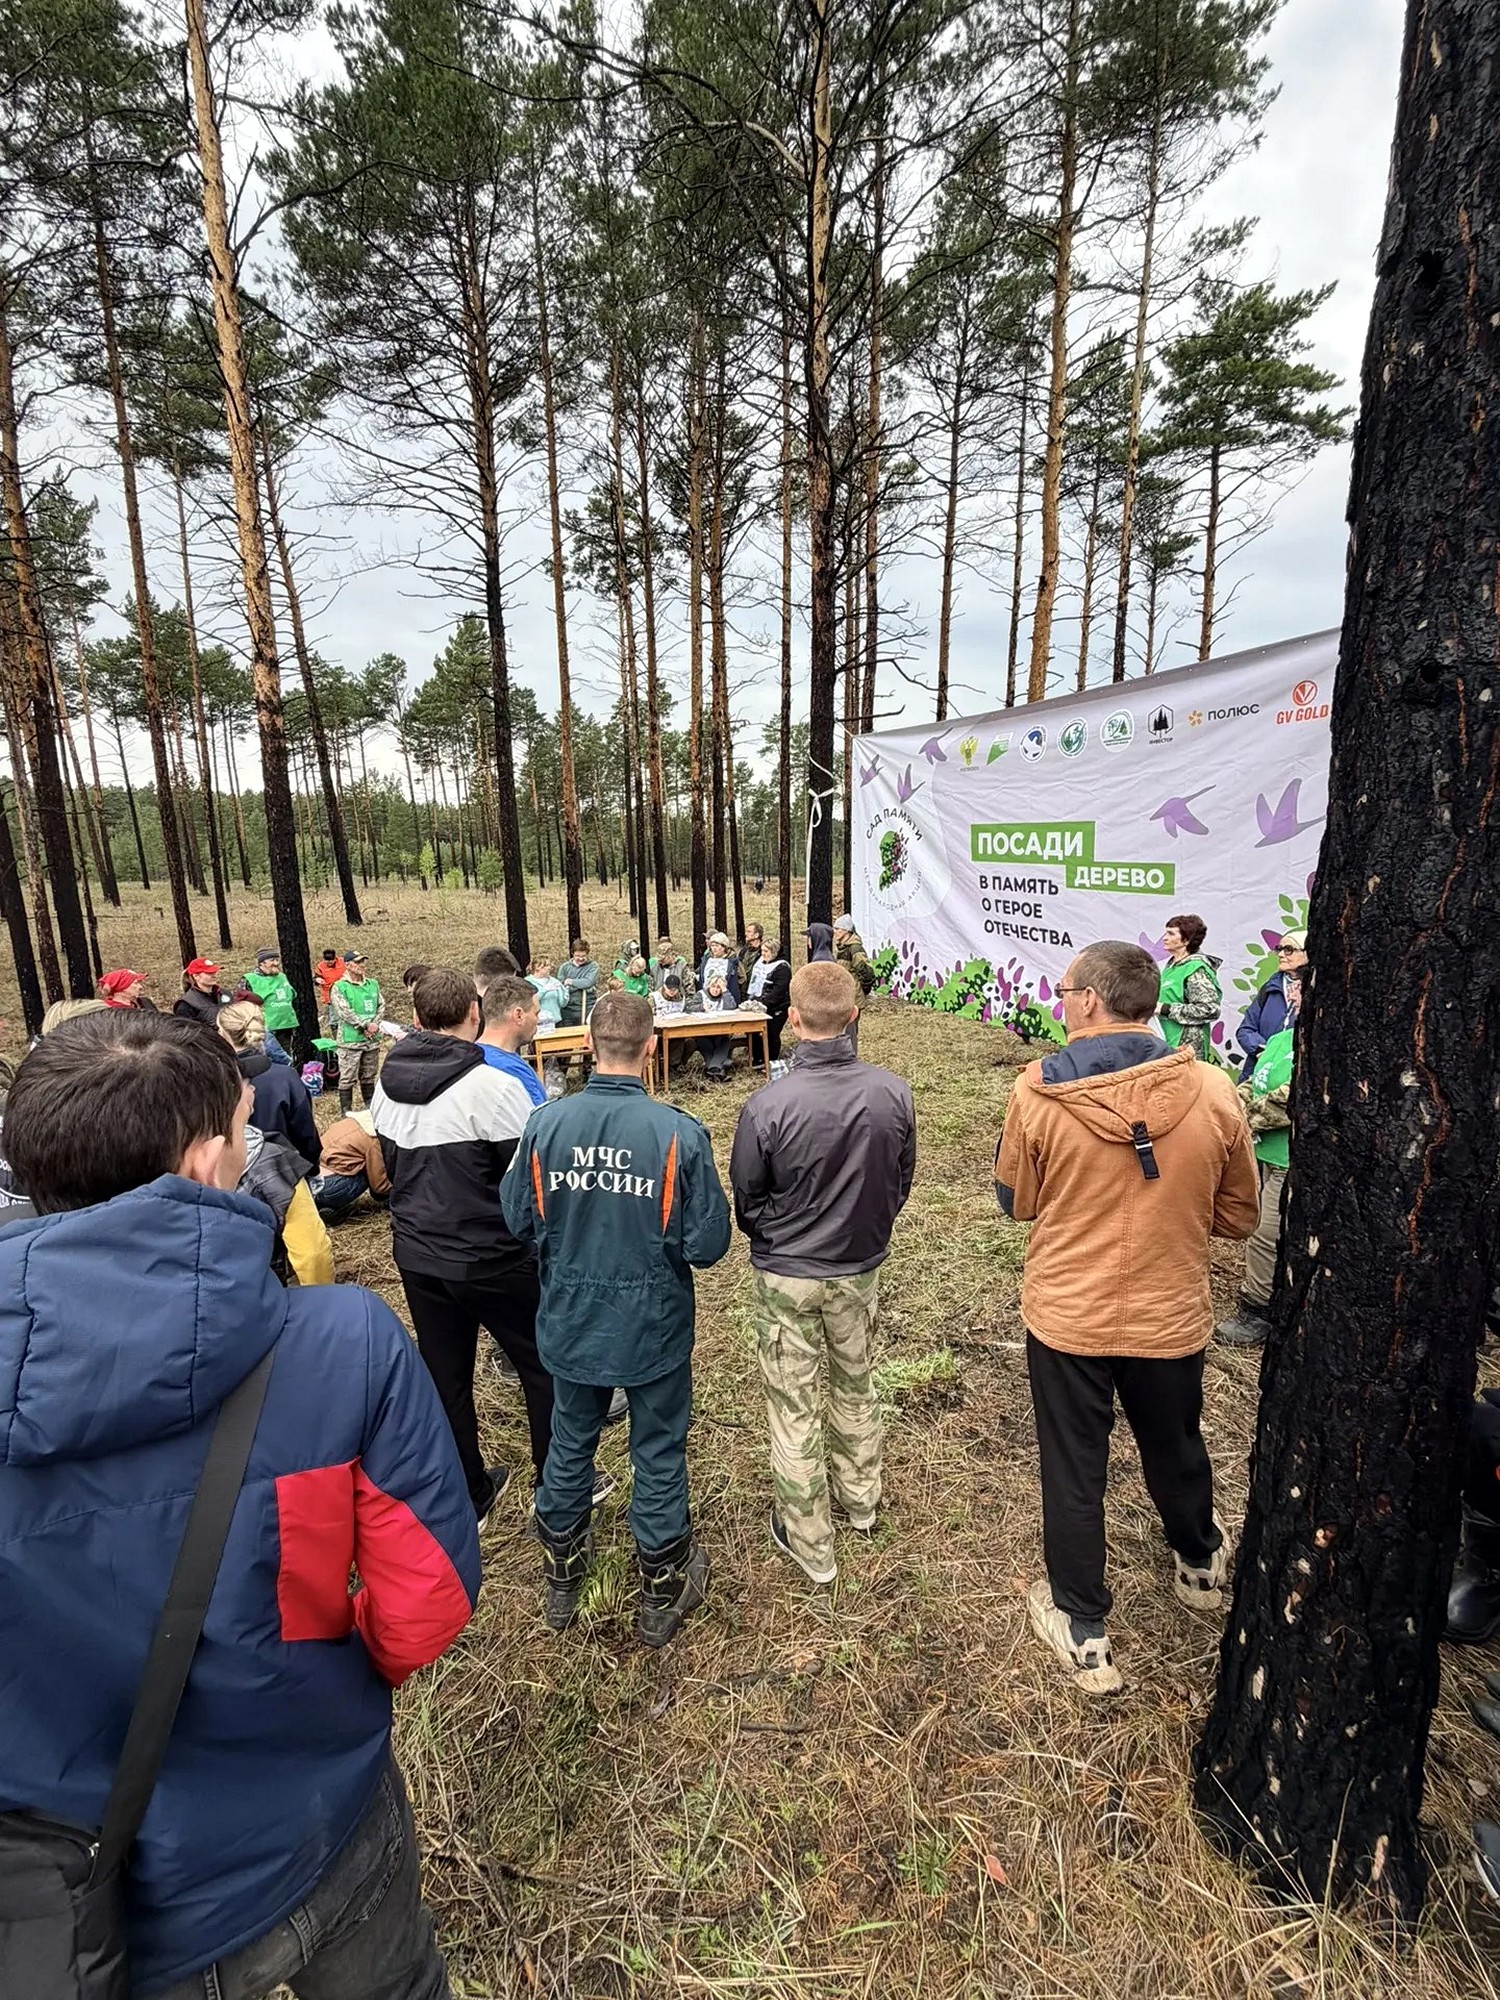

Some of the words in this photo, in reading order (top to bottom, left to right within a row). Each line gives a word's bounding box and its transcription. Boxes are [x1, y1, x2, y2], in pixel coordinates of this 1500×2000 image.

[1208, 703, 1260, 721] ПОЛЮС
[1276, 710, 1294, 724] GV
[1295, 704, 1329, 722] GOLD
[866, 814, 882, 839] САД
[883, 808, 922, 841] ПАМЯТИ
[977, 831, 1083, 861] ПОСАДИ
[979, 875, 989, 889] В
[992, 875, 1059, 896] ПАМЯТЬ
[1074, 866, 1165, 889] ДЕРЕВО
[981, 898, 992, 911] О
[994, 899, 1043, 919] ГЕРОЕ
[984, 919, 1074, 948] ОТЕЧЕСТВА
[572, 1146, 632, 1170] МЧС
[548, 1169, 656, 1199] РОССИИ
